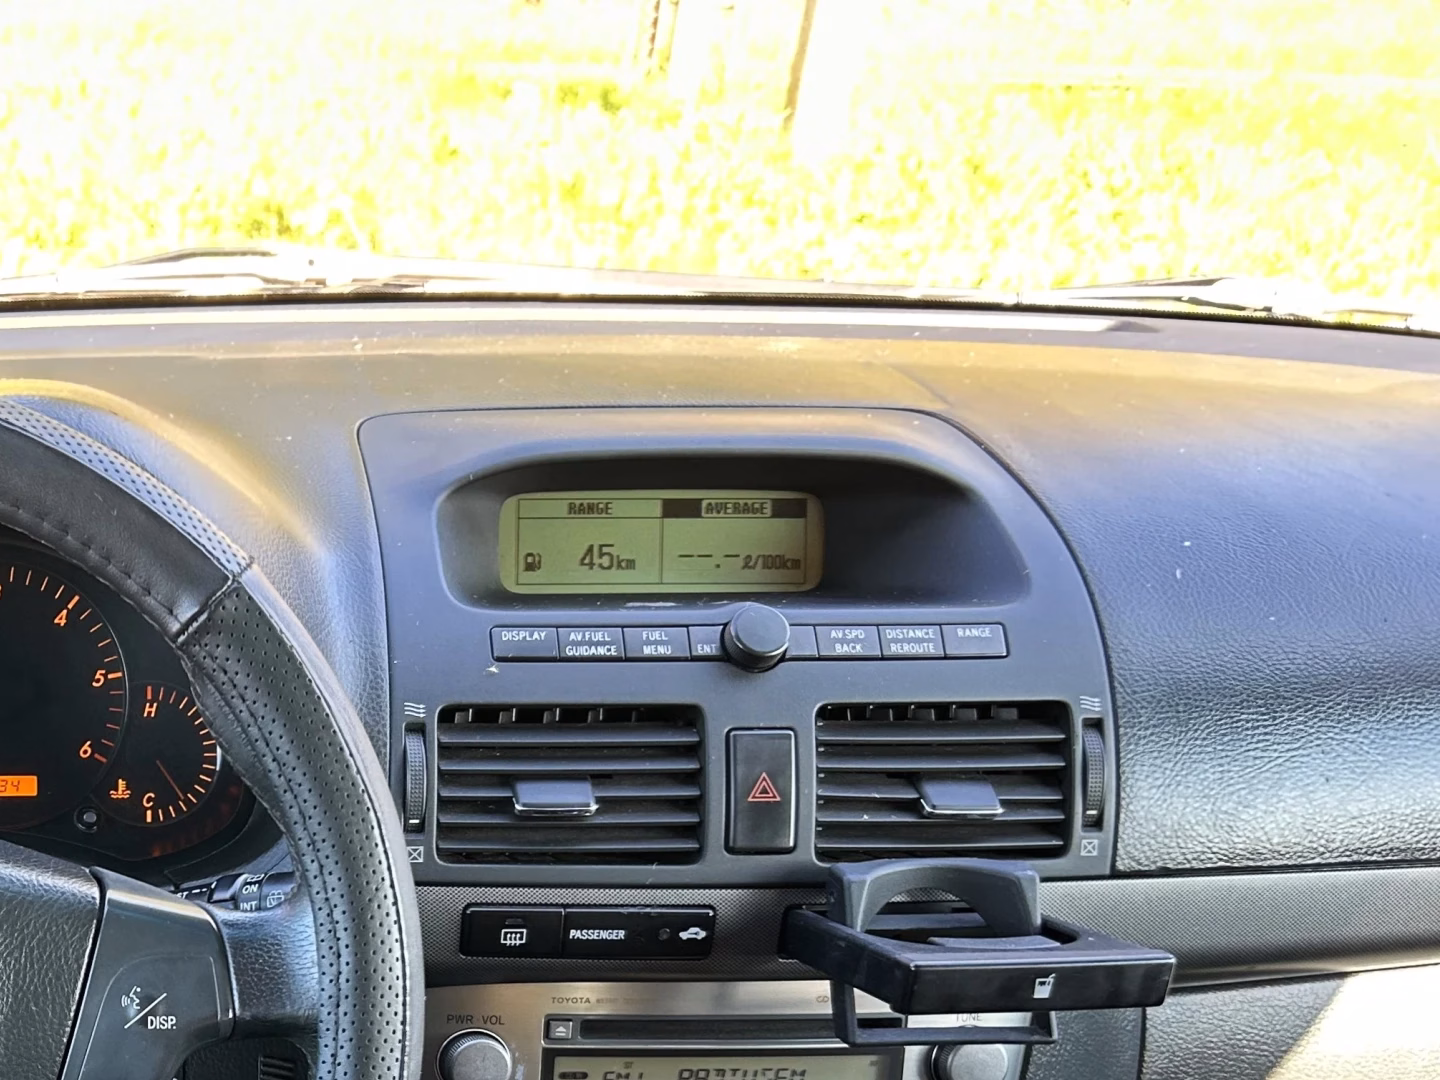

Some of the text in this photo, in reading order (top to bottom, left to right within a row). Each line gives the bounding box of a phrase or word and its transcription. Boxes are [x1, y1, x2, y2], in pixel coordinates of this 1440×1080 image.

[567, 502, 613, 515] RANGE
[704, 502, 769, 515] AVERAGE
[54, 610, 68, 627] 4
[501, 630, 547, 641] DISPLAY
[569, 632, 611, 642] AV.FUEL
[642, 632, 668, 641] FUEL
[830, 628, 866, 639] AV.SPD
[886, 628, 935, 639] DISTANCE
[957, 627, 992, 638] RANGE
[565, 645, 617, 656] GUIDANCE
[642, 645, 672, 655] MENU
[697, 644, 716, 654] ENT
[835, 643, 863, 654] BACK
[890, 642, 935, 654] REROUTE
[92, 670, 105, 686] 5
[144, 703, 157, 717] H
[79, 742, 92, 758] 6
[143, 793, 155, 808] C
[242, 884, 258, 894] ON
[240, 902, 257, 910] INT
[570, 930, 625, 940] PASSENGER
[147, 1015, 177, 1030] DISP.
[447, 1014, 505, 1025] PWR VOL
[956, 1013, 982, 1022] TUNE
